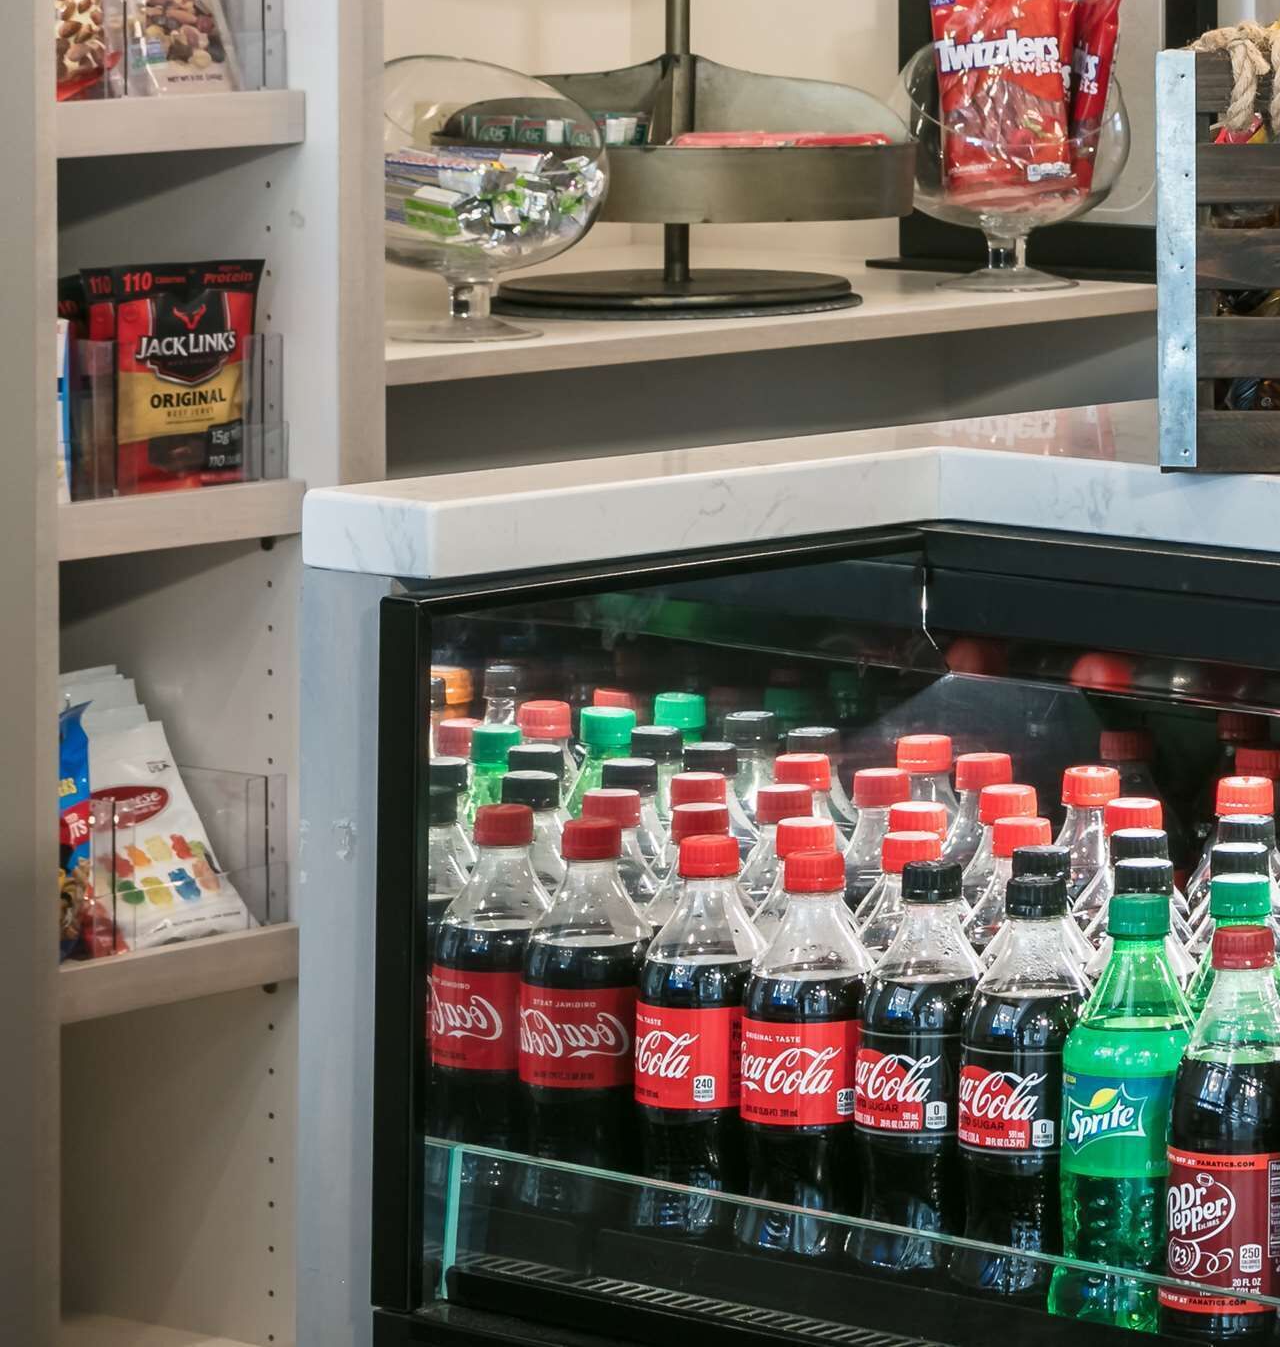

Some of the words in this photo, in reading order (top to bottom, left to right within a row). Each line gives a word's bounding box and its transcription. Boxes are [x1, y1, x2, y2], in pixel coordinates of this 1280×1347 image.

[935, 30, 1061, 74] Twizzlers
[123, 272, 154, 293] 110
[203, 271, 254, 286] Protein
[136, 335, 187, 360] JACK
[150, 387, 227, 409] ORIGINAL
[644, 1017, 662, 1027] TASTE
[746, 1030, 773, 1043] ORIGINAL
[775, 1036, 801, 1044] TASTE
[695, 1078, 712, 1089] 240
[838, 1090, 854, 1103] 240
[868, 1103, 898, 1114] SUGAR
[933, 1105, 940, 1116] 0
[973, 1120, 1005, 1132] SUGAR
[1040, 1123, 1047, 1135] 0
[1068, 1103, 1138, 1143] Sprite
[1187, 1158, 1195, 1166] AT
[1196, 1160, 1256, 1168] FANATICS.COM
[1181, 1183, 1207, 1206] Dr
[1167, 1185, 1228, 1236] Pepper
[1174, 1245, 1188, 1266] 23
[1242, 1247, 1260, 1259] 250
[1232, 1278, 1242, 1287] 20
[1242, 1278, 1250, 1287] FL
[1252, 1277, 1262, 1286] OZ
